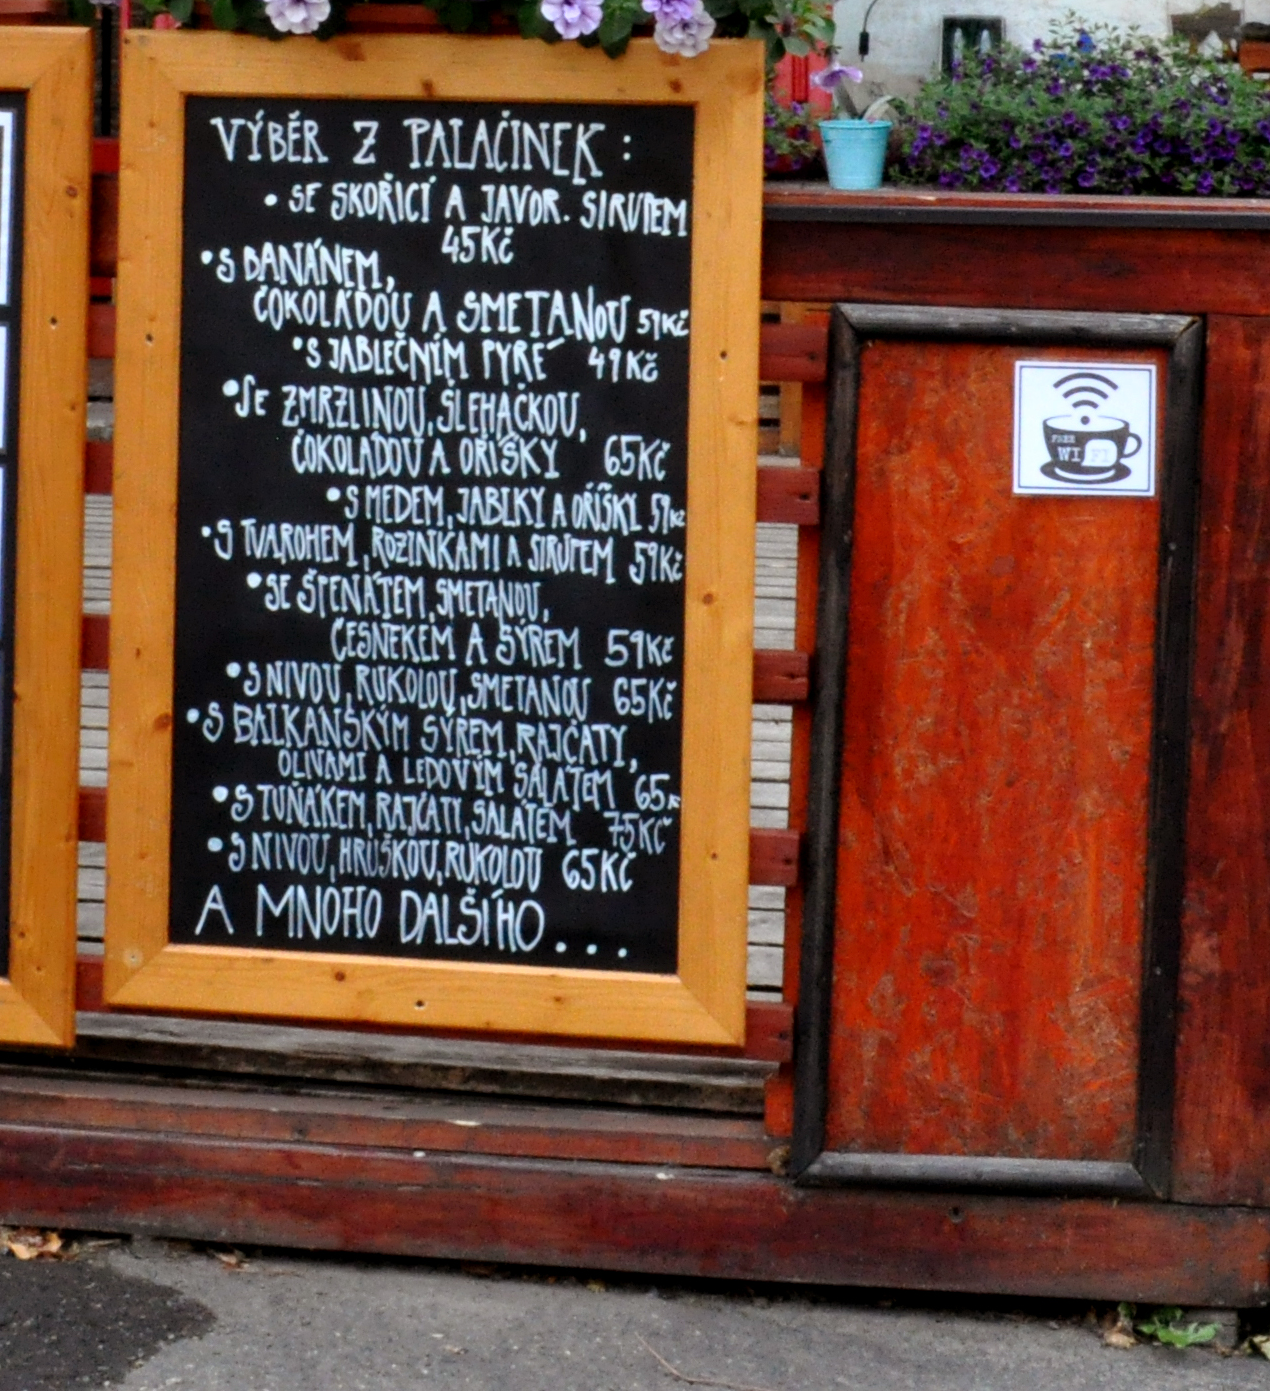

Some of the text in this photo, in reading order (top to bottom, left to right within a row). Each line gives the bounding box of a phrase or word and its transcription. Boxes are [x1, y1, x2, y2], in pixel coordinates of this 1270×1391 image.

[212, 111, 604, 185] VÝBĚR Z PALAČINEK
[289, 183, 321, 211] SE
[331, 173, 437, 223] SKOŘICÍ
[445, 184, 466, 221] A
[581, 190, 687, 237] SIRUPEM
[216, 250, 235, 282] S
[254, 286, 631, 343] ČOKOLÁDOU A SMETANOU
[306, 339, 321, 368] S
[236, 375, 269, 417] SE
[429, 443, 450, 476] A
[1058, 447, 1080, 462] WI
[345, 488, 359, 519] S
[456, 487, 545, 528] JABLKY
[551, 495, 566, 530] A
[214, 520, 232, 560] S
[507, 536, 520, 568] A
[529, 533, 615, 584] SIRUPEM
[264, 574, 291, 610] SE
[466, 625, 485, 667] A
[496, 619, 581, 669] SÝREM
[244, 665, 261, 697] S
[467, 672, 591, 722] SMETANOU
[202, 703, 224, 743] S
[278, 750, 366, 784] OLIVAMI
[376, 758, 392, 785] A
[231, 785, 254, 823] S
[229, 834, 247, 872] S
[445, 840, 541, 891] RUKOLOU
[195, 884, 545, 953] A MNOHO DALŠÍHO
